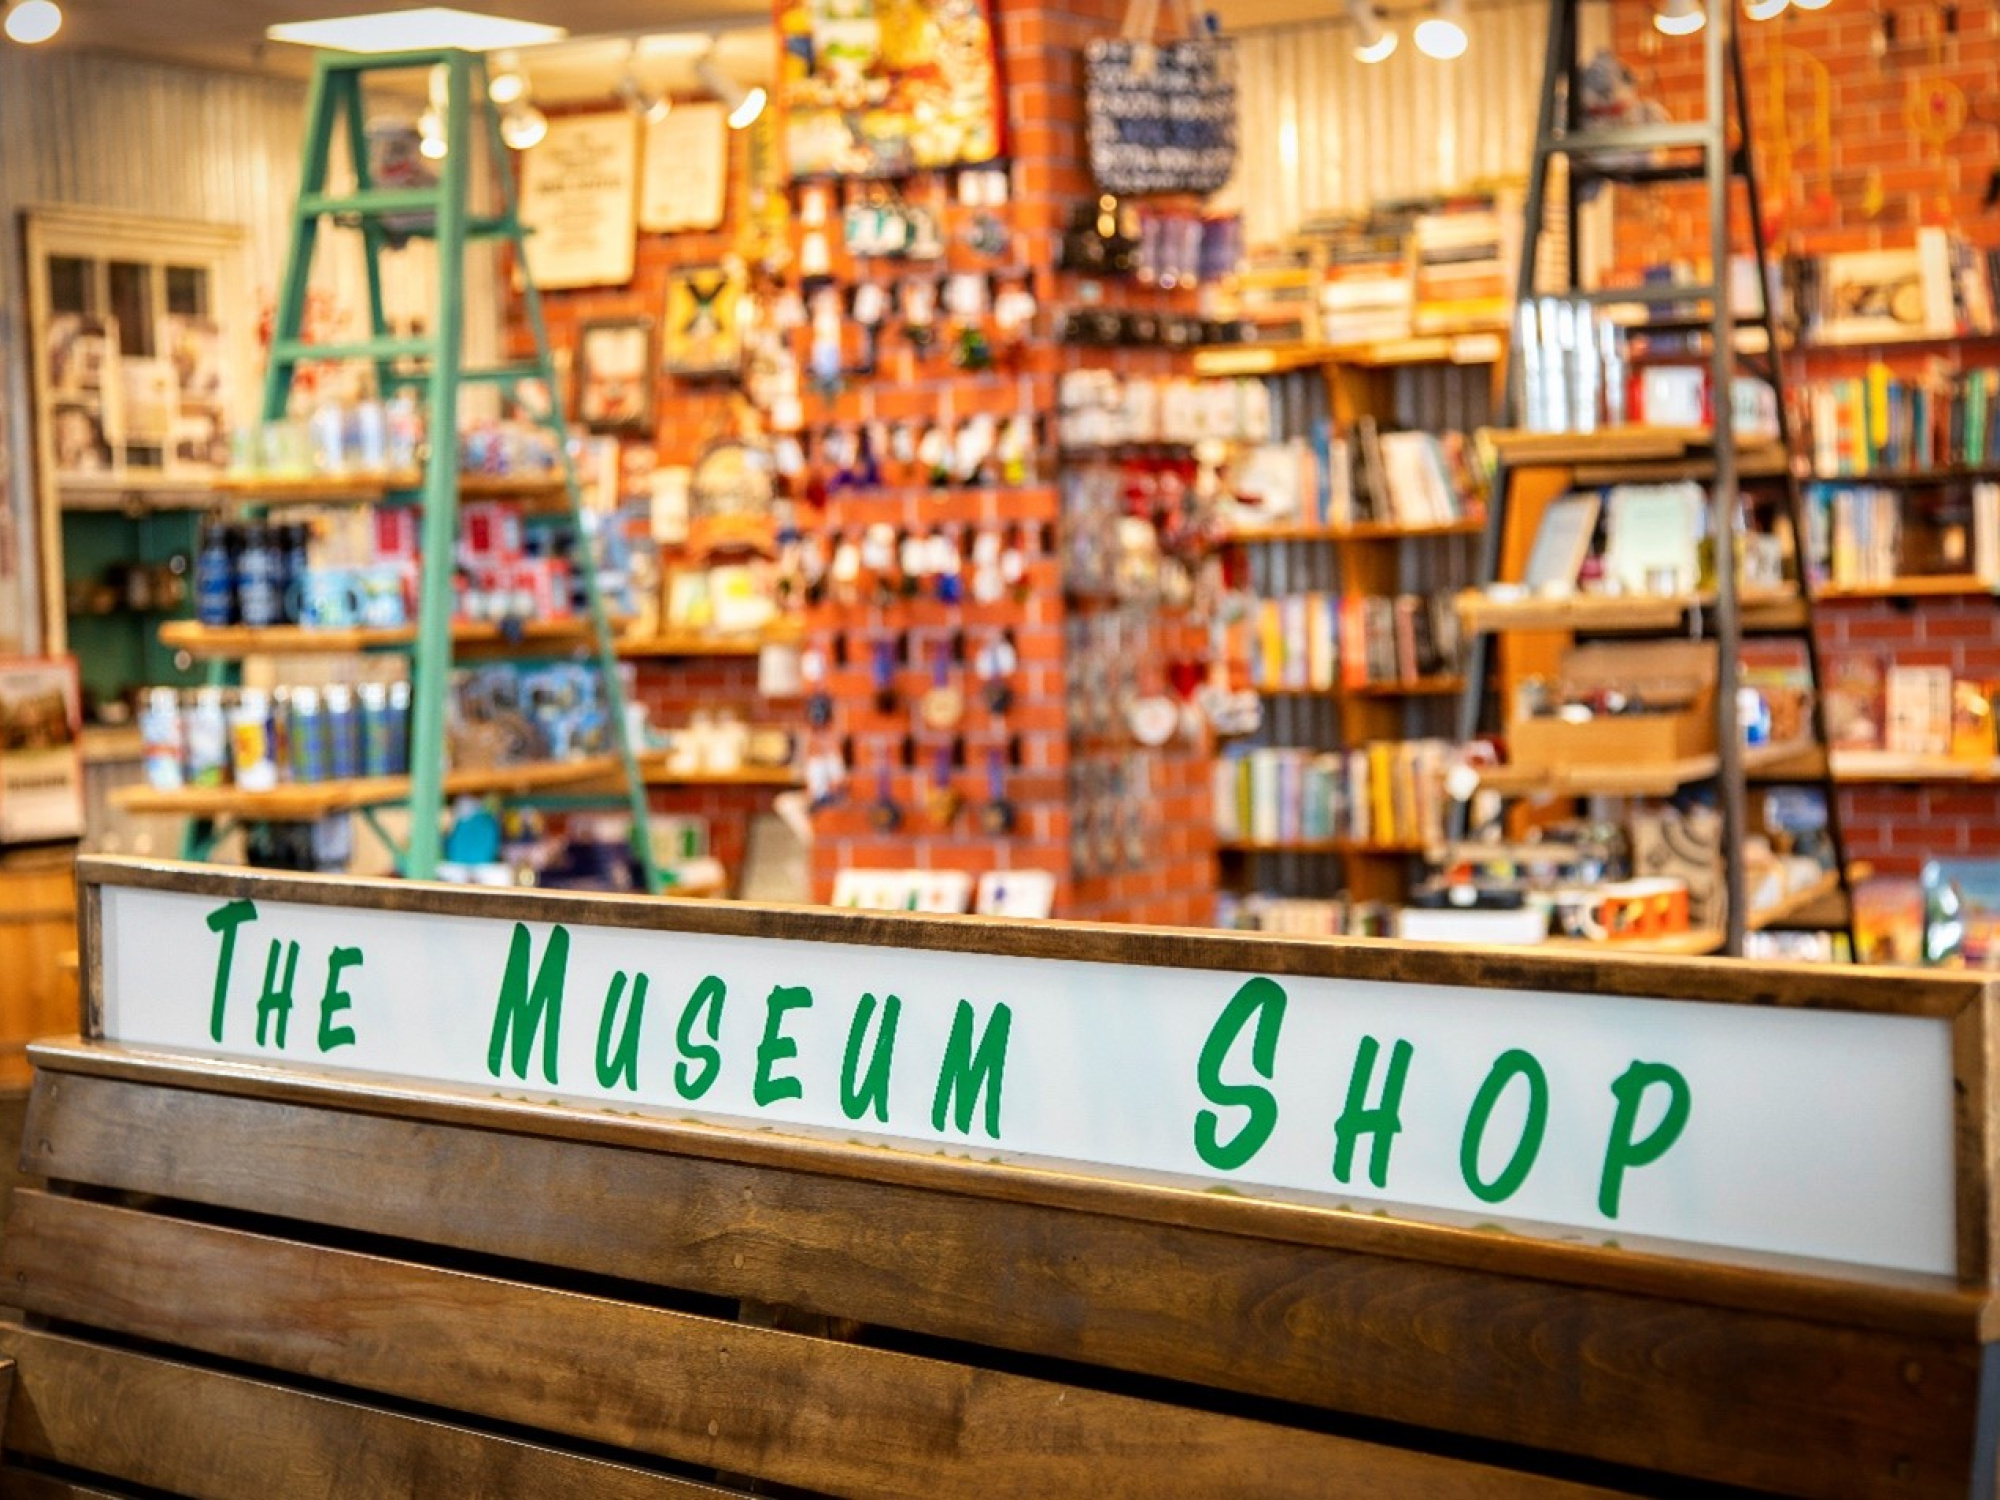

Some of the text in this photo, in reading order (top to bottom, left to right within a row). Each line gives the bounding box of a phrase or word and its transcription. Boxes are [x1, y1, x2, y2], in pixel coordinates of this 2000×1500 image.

[206, 899, 1691, 1219] THE MUSEUM SHOP
